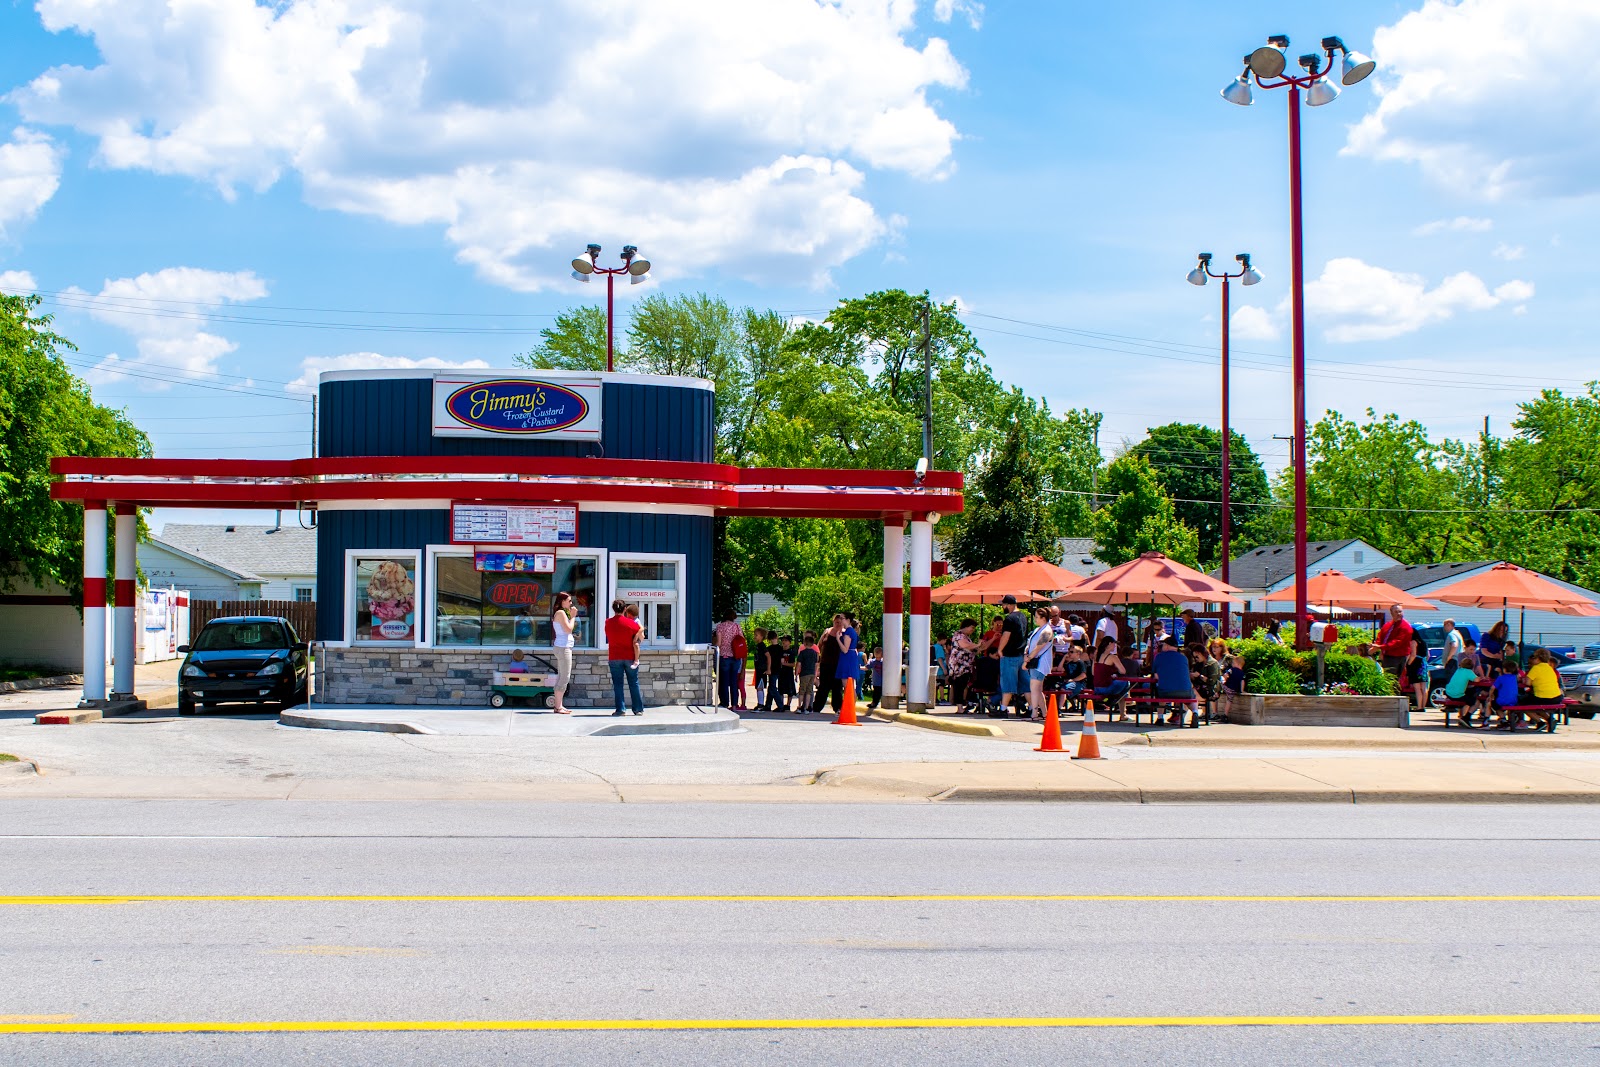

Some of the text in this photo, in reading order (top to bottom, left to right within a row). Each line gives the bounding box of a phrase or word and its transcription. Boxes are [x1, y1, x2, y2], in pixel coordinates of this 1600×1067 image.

[470, 387, 546, 419] Jimmy's
[503, 405, 565, 420] Frozen Custard
[521, 417, 557, 428] & Pasties
[492, 583, 539, 604] OPEN
